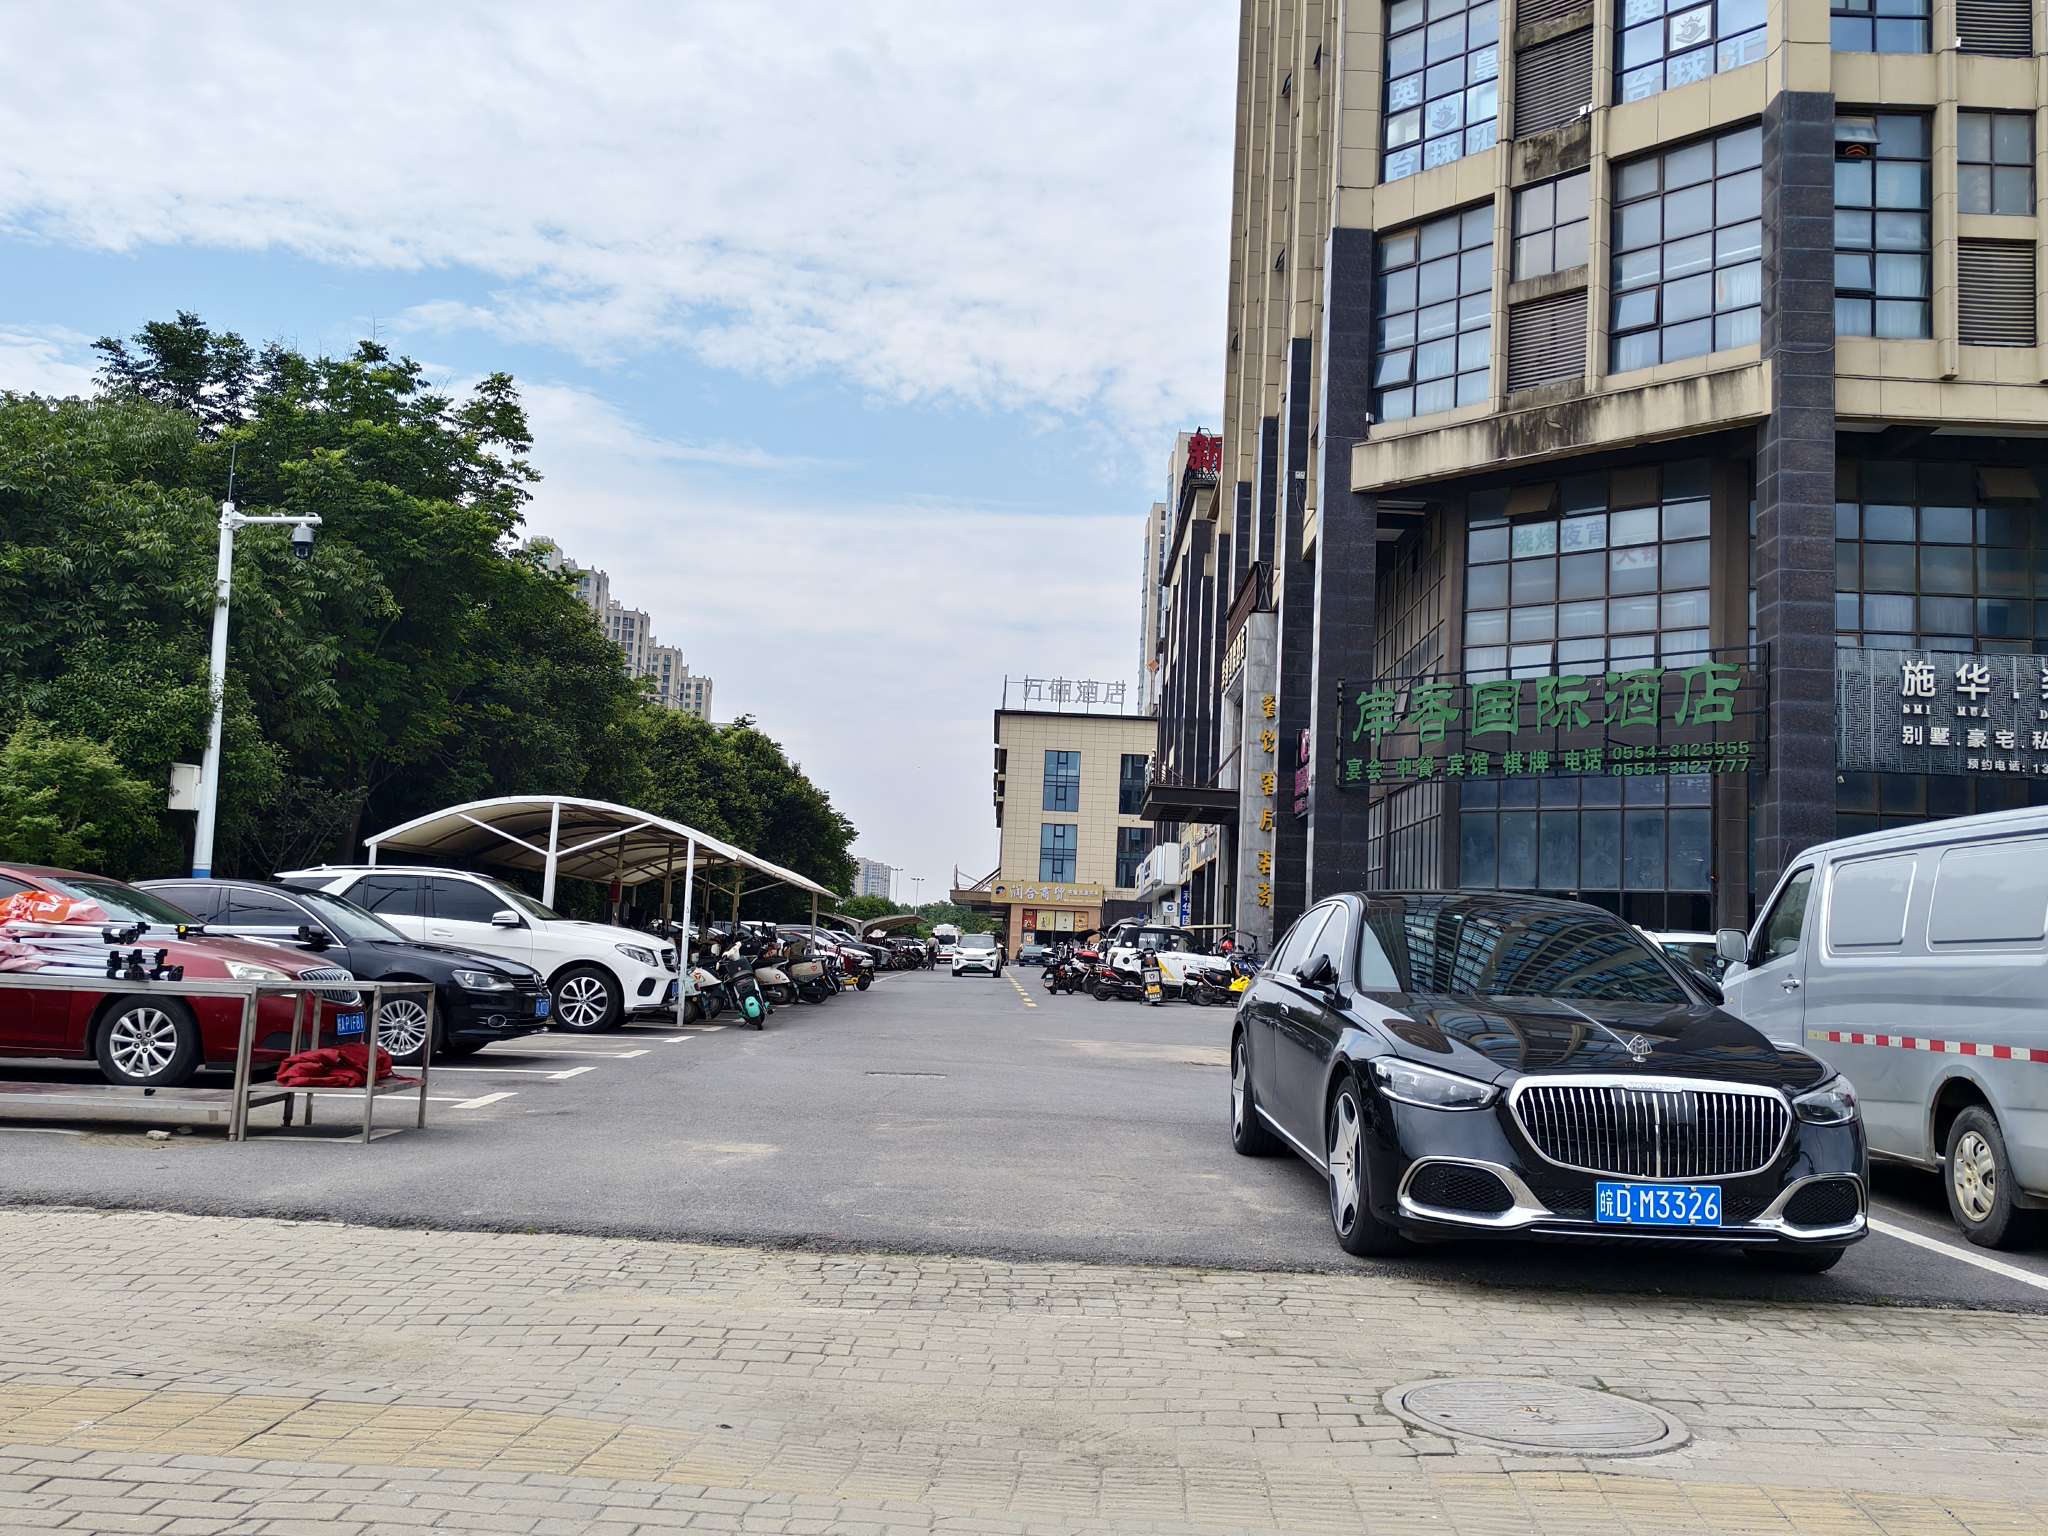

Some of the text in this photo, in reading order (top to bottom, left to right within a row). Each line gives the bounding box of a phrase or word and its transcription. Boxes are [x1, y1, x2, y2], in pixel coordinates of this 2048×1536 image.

[1352, 660, 1744, 746] 岸香国际酒店
[1612, 741, 1750, 760] 0554-3125555
[1346, 747, 1603, 781] 宴会 中餐 宾馆 棋牌 电话
[1612, 758, 1750, 777] 0554-3127777
